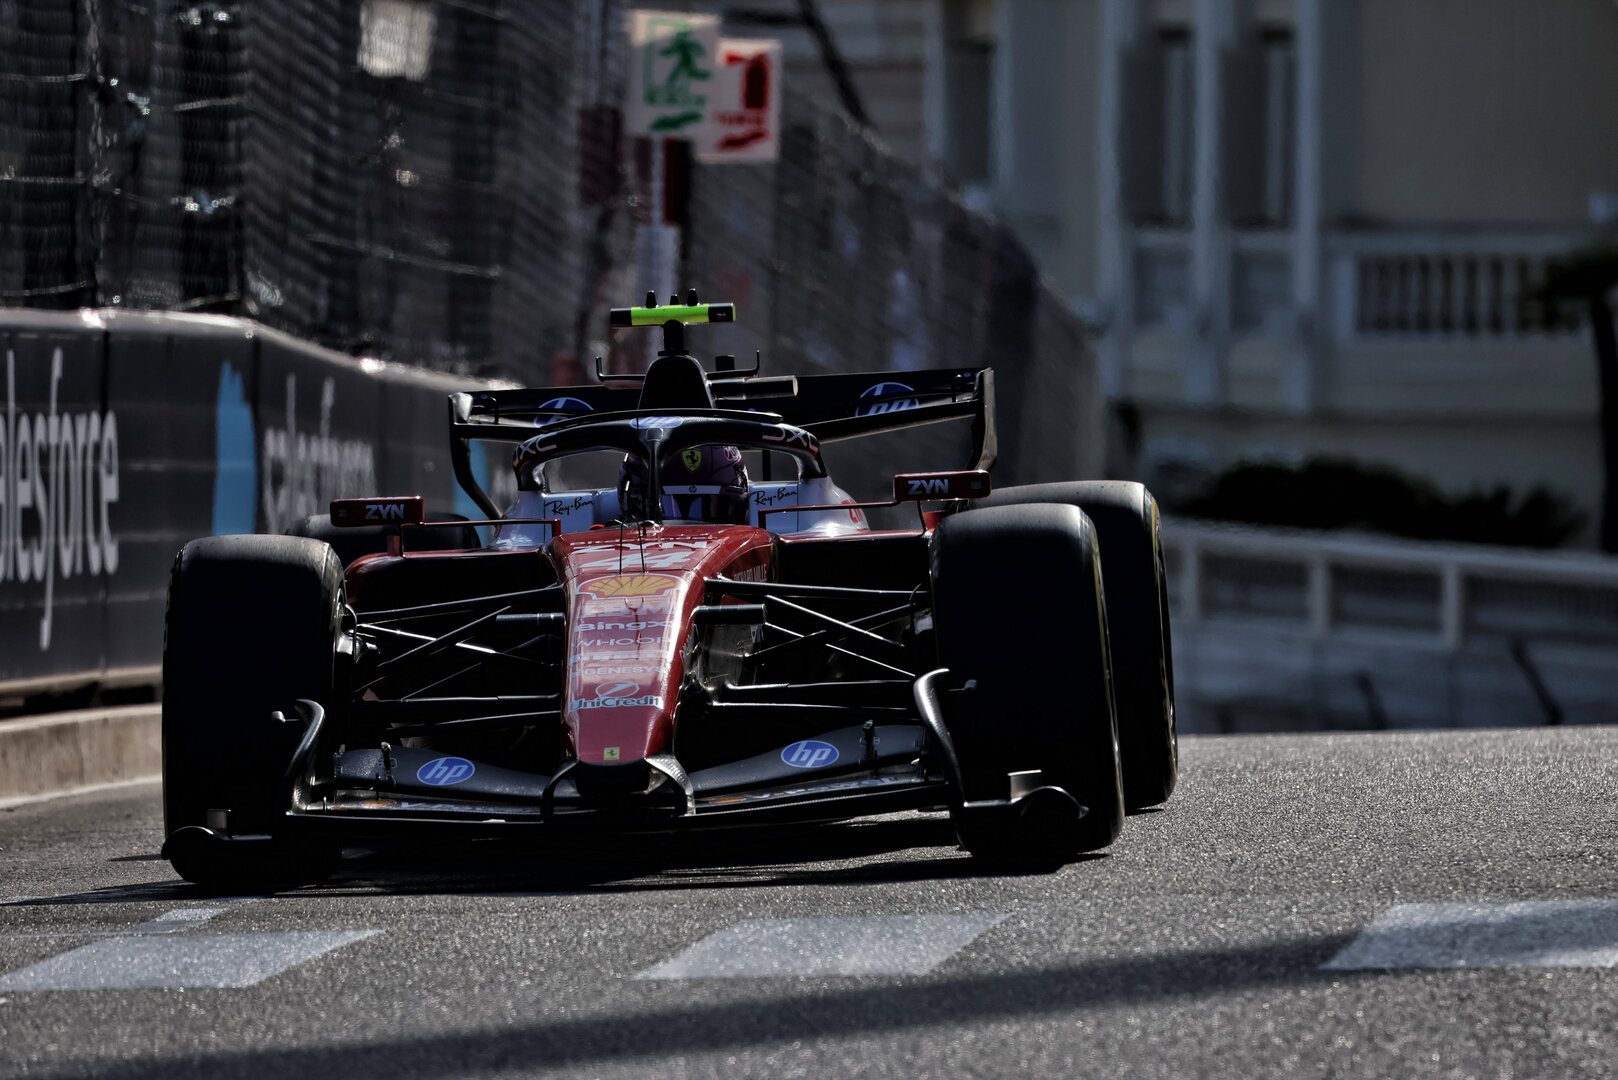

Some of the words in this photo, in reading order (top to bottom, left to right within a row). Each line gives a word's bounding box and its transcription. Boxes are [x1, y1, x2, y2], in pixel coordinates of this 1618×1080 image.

[908, 479, 950, 495] ZYN
[750, 488, 797, 506] Ray-Ban
[365, 504, 405, 520] ZYN
[545, 497, 594, 515] Ray-Ban
[572, 541, 708, 553] ZYN
[579, 551, 695, 570] 44
[574, 620, 672, 633] BingX
[571, 695, 659, 708] UniCredit
[788, 741, 833, 768] hp
[422, 757, 469, 786] hp
